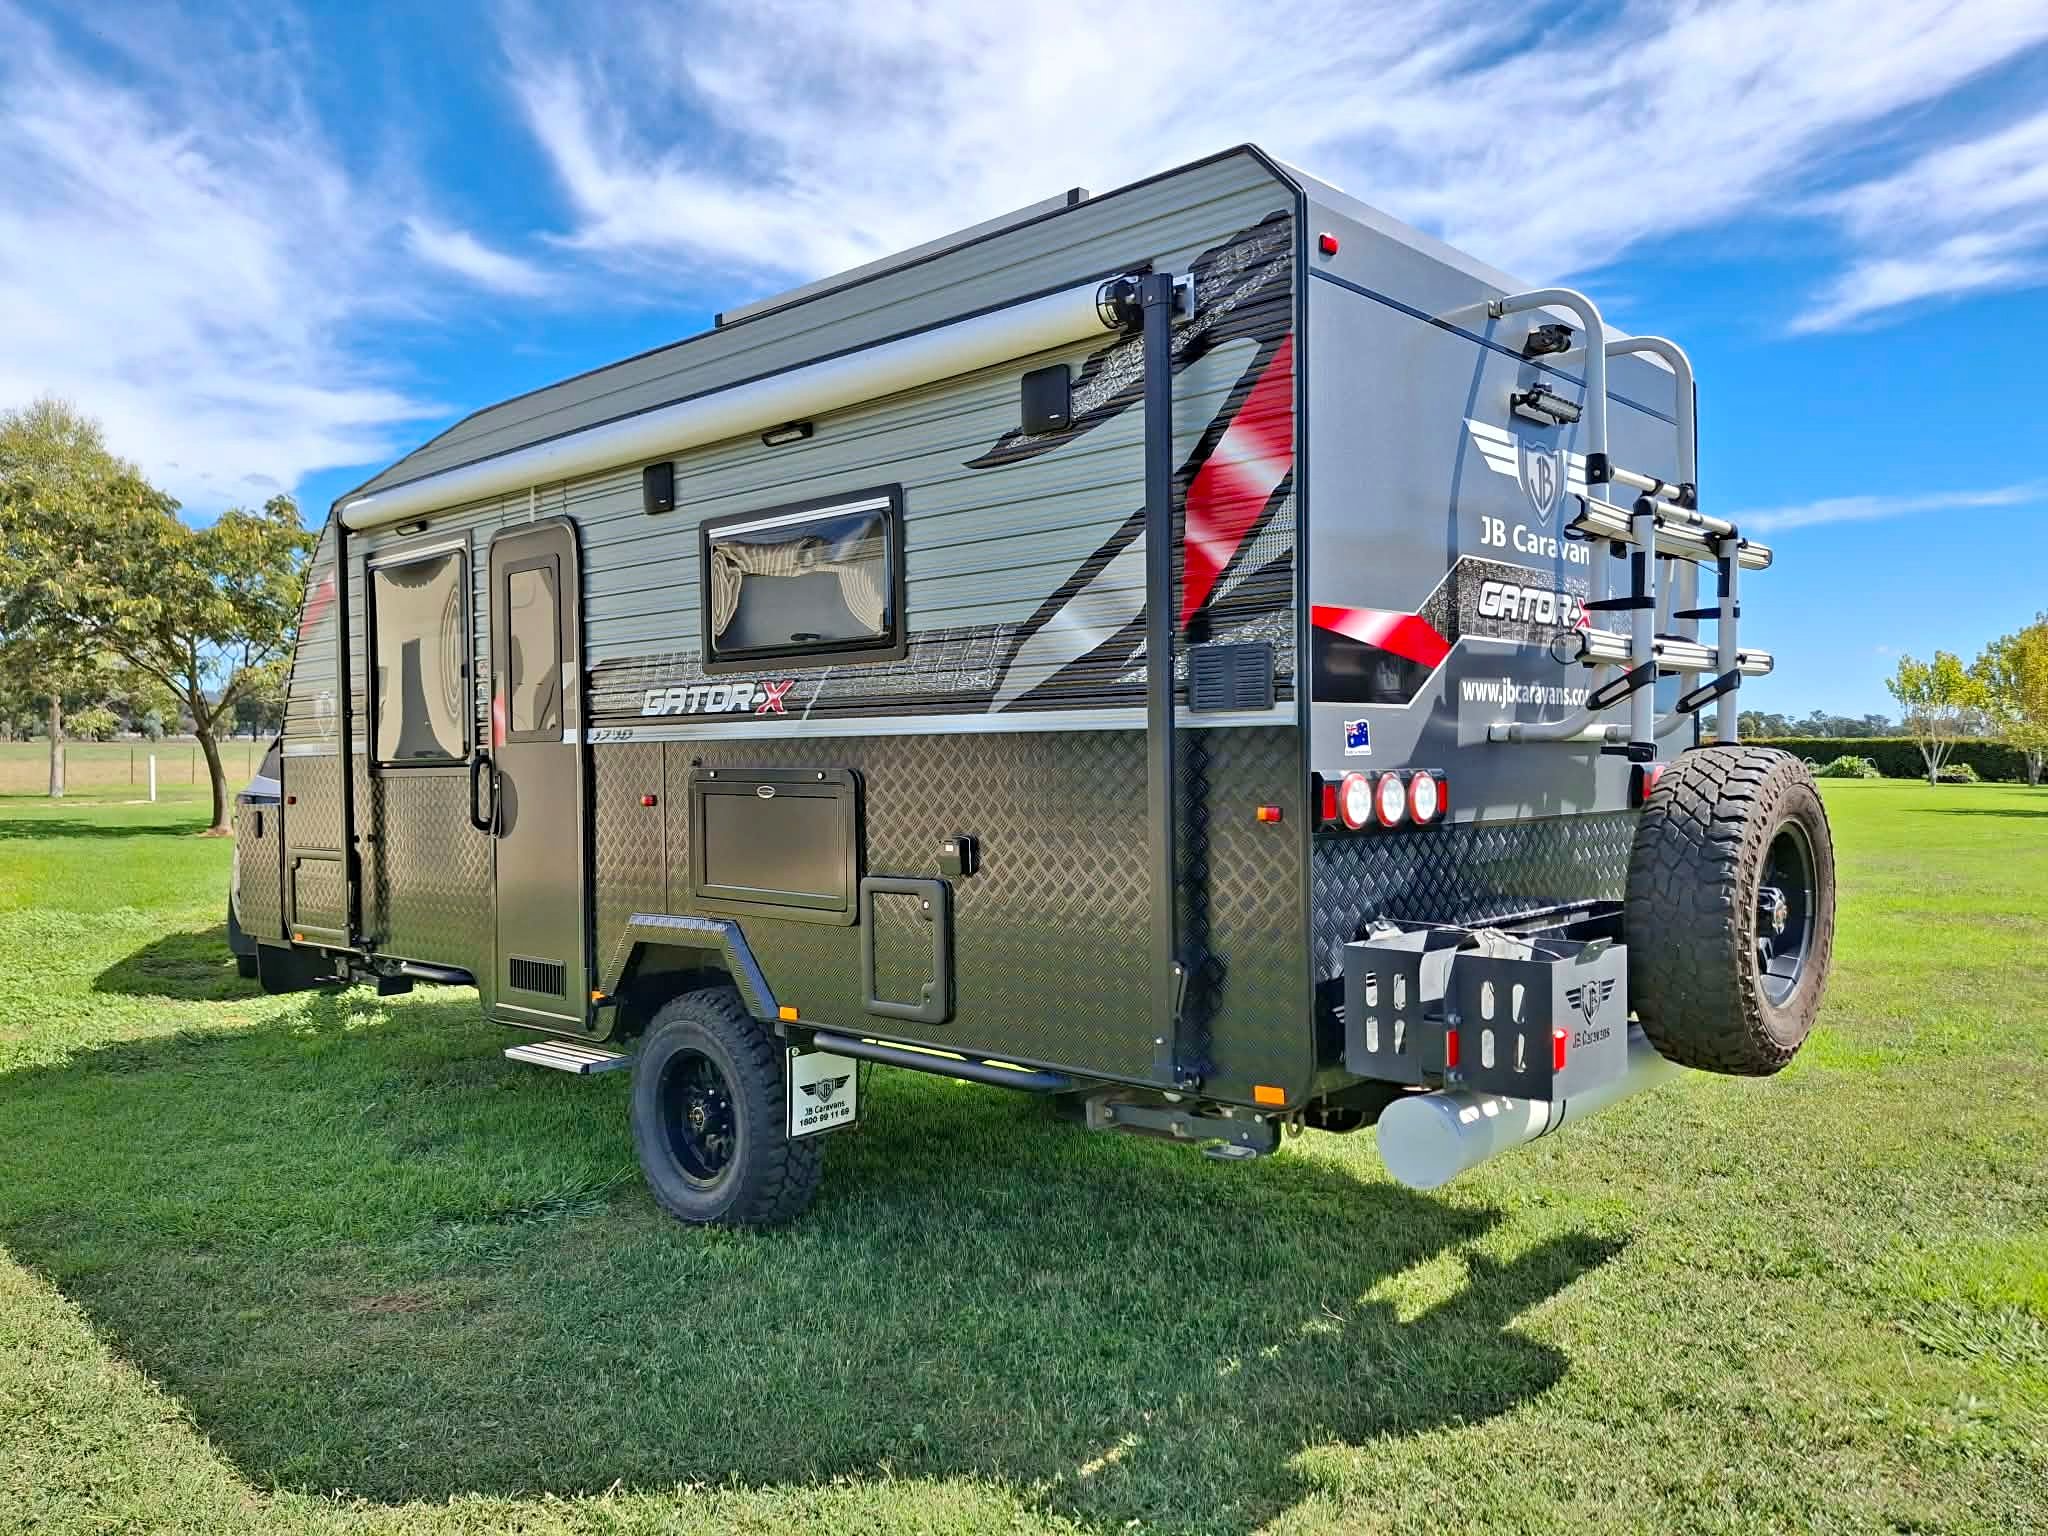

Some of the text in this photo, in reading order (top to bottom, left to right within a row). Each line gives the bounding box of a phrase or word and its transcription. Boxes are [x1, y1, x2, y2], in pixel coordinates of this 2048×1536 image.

[1480, 516, 1590, 566] JB Caravan
[1478, 580, 1591, 633] GATOR-X
[640, 680, 795, 716] GATOR-X
[800, 1116, 817, 1127] 1800
[831, 1110, 838, 1119] 11
[805, 1101, 845, 1116] JB Caravans
